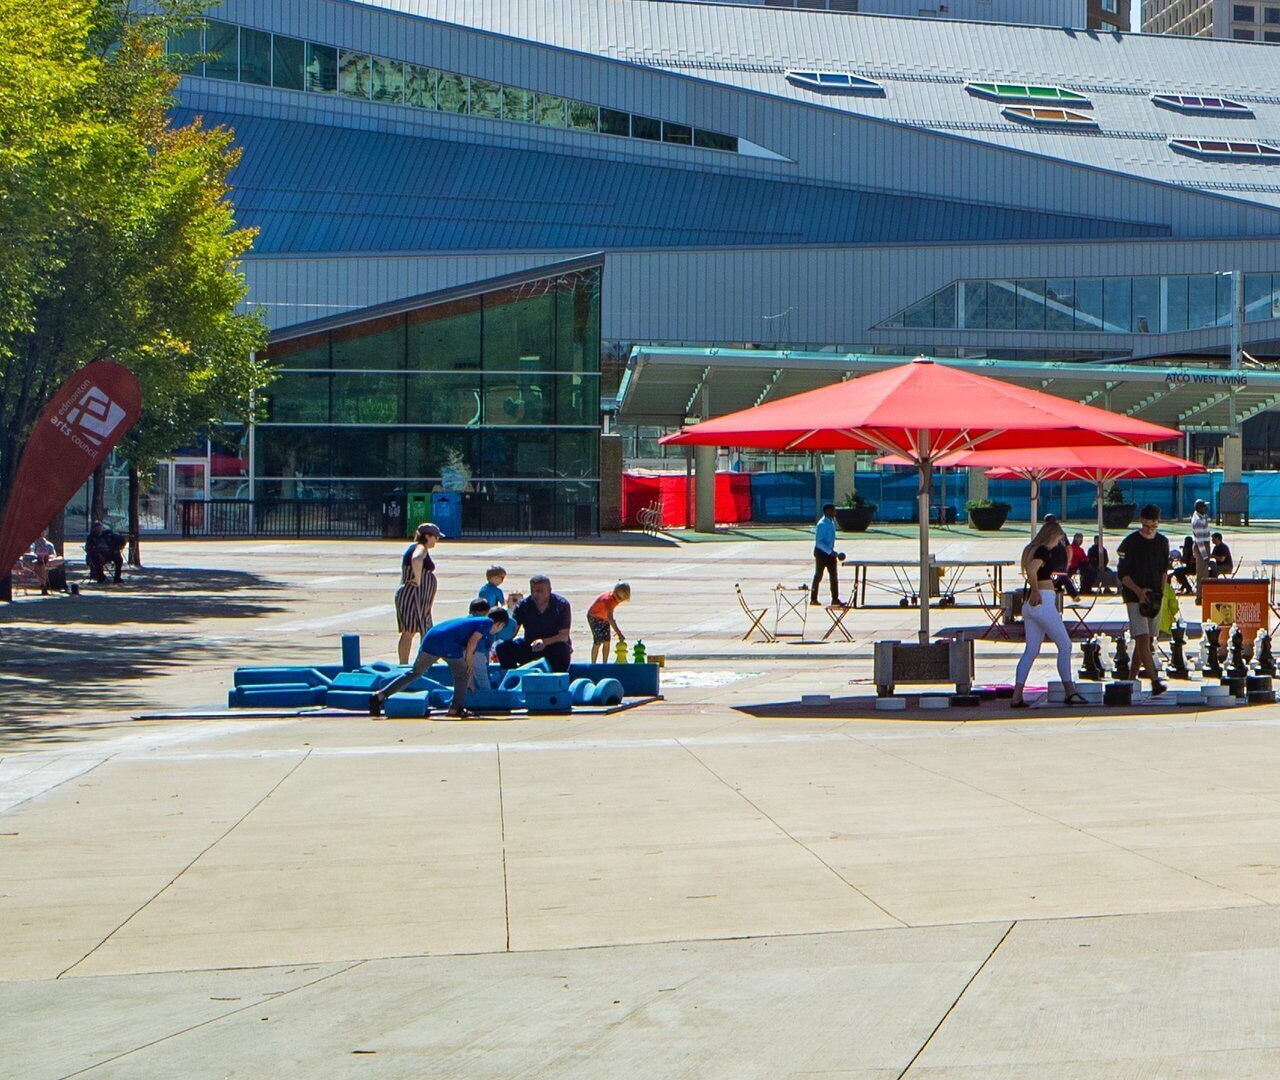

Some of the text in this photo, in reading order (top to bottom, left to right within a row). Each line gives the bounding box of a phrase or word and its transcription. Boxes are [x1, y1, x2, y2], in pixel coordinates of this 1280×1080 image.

[58, 379, 91, 416] edmonton
[1165, 373, 1248, 385] ATCO WEST WING
[50, 415, 98, 459] arts council
